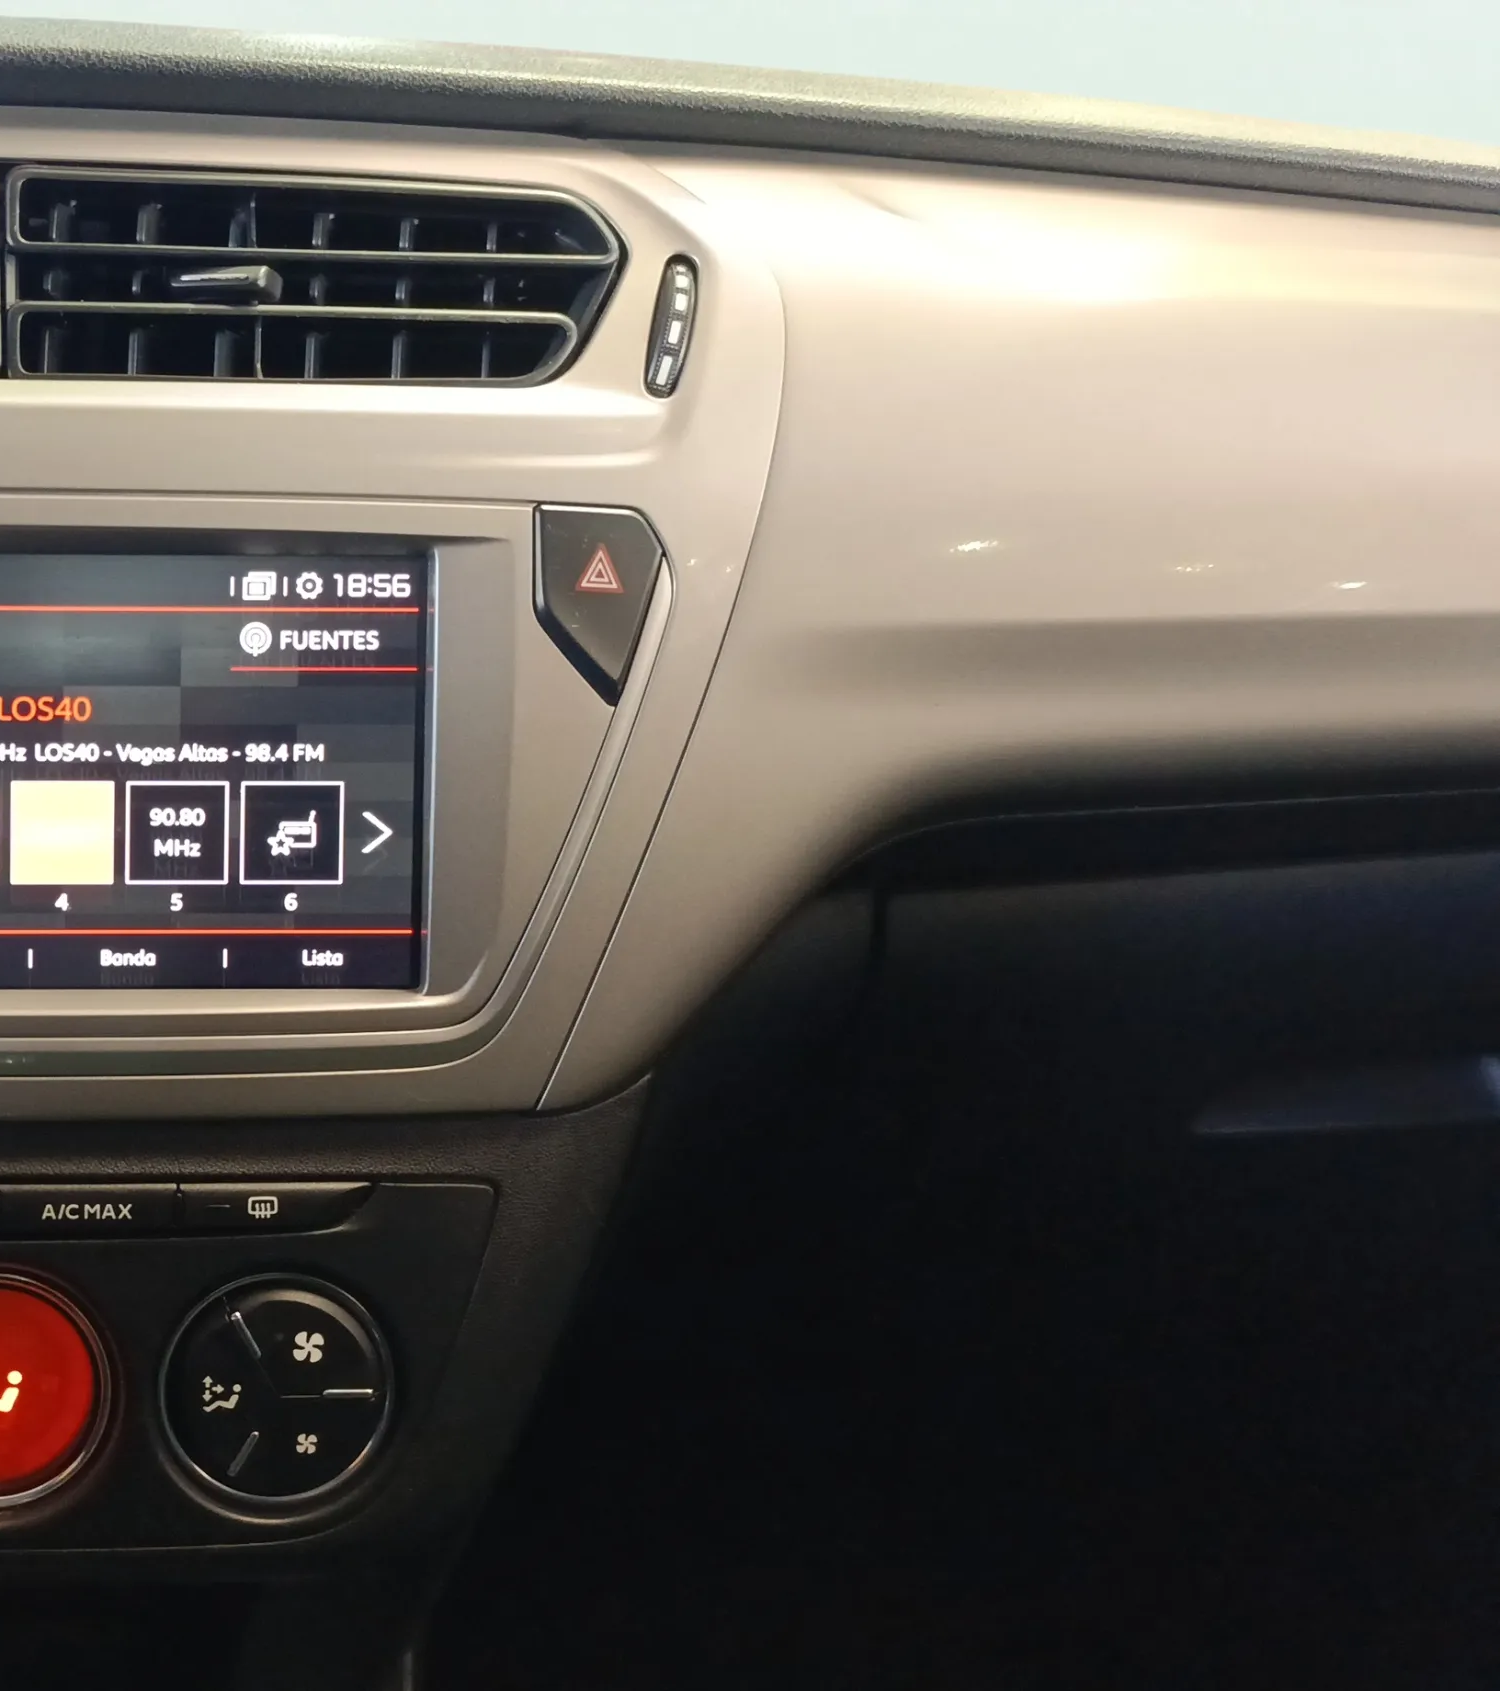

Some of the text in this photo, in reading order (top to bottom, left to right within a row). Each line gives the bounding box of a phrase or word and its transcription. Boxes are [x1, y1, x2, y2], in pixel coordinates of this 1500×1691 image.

[332, 573, 411, 598] 18:56
[279, 629, 380, 651] FUENTES
[34, 742, 100, 762] LOS40
[115, 742, 175, 767] Vegas
[178, 742, 229, 763] Altas
[244, 743, 289, 763] 98.4
[292, 743, 325, 763] FM
[149, 807, 206, 828] 90.80
[153, 838, 202, 858] MHz
[54, 892, 68, 912] 4
[169, 892, 184, 912] 5
[283, 892, 299, 912] 6
[100, 948, 157, 968] Banda
[301, 948, 344, 968] Lista
[41, 1203, 134, 1220] A/C MAX
